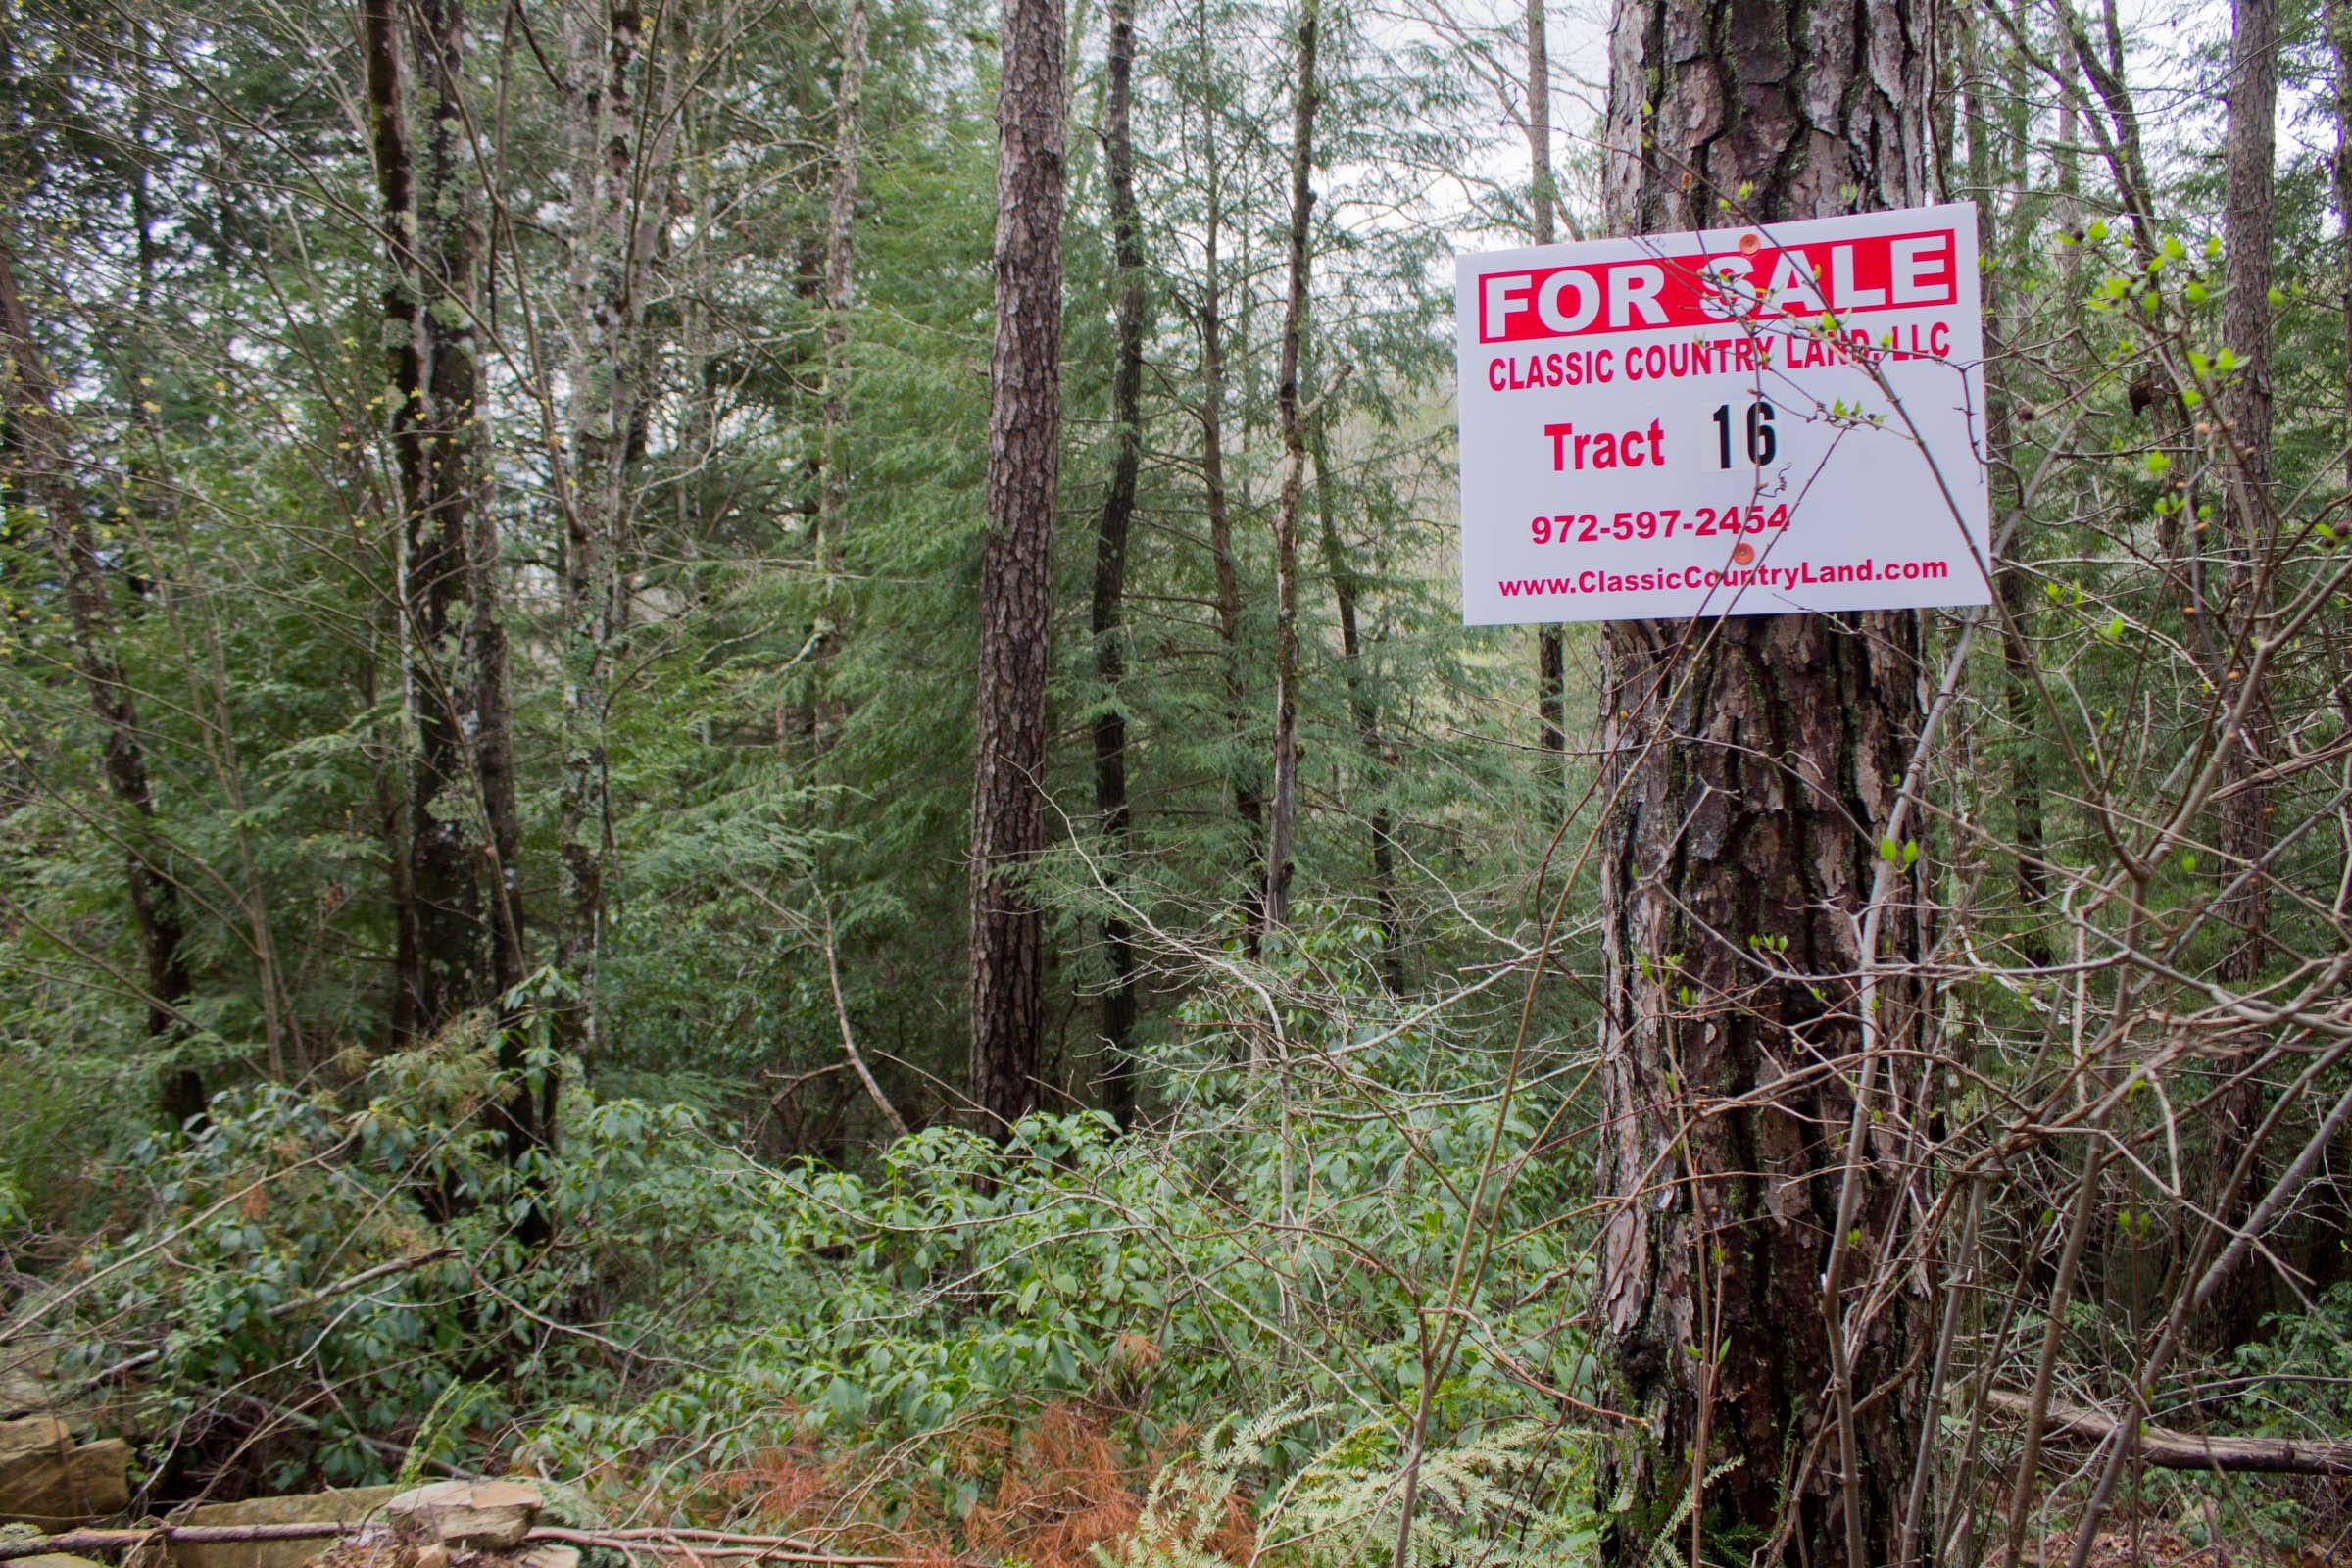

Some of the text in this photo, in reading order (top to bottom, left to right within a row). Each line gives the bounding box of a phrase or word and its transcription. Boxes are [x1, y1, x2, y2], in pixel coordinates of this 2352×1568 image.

[1485, 235, 1949, 338] FOR SALE
[1489, 348, 1614, 392] CLASSIC
[1624, 334, 1775, 380] COUNTRY
[1892, 321, 1950, 360] LLC
[1544, 402, 1777, 471] Tract 16
[1531, 504, 1789, 545] 972-597-2454
[1498, 559, 1948, 597] www.ClassicCountryLand.com
